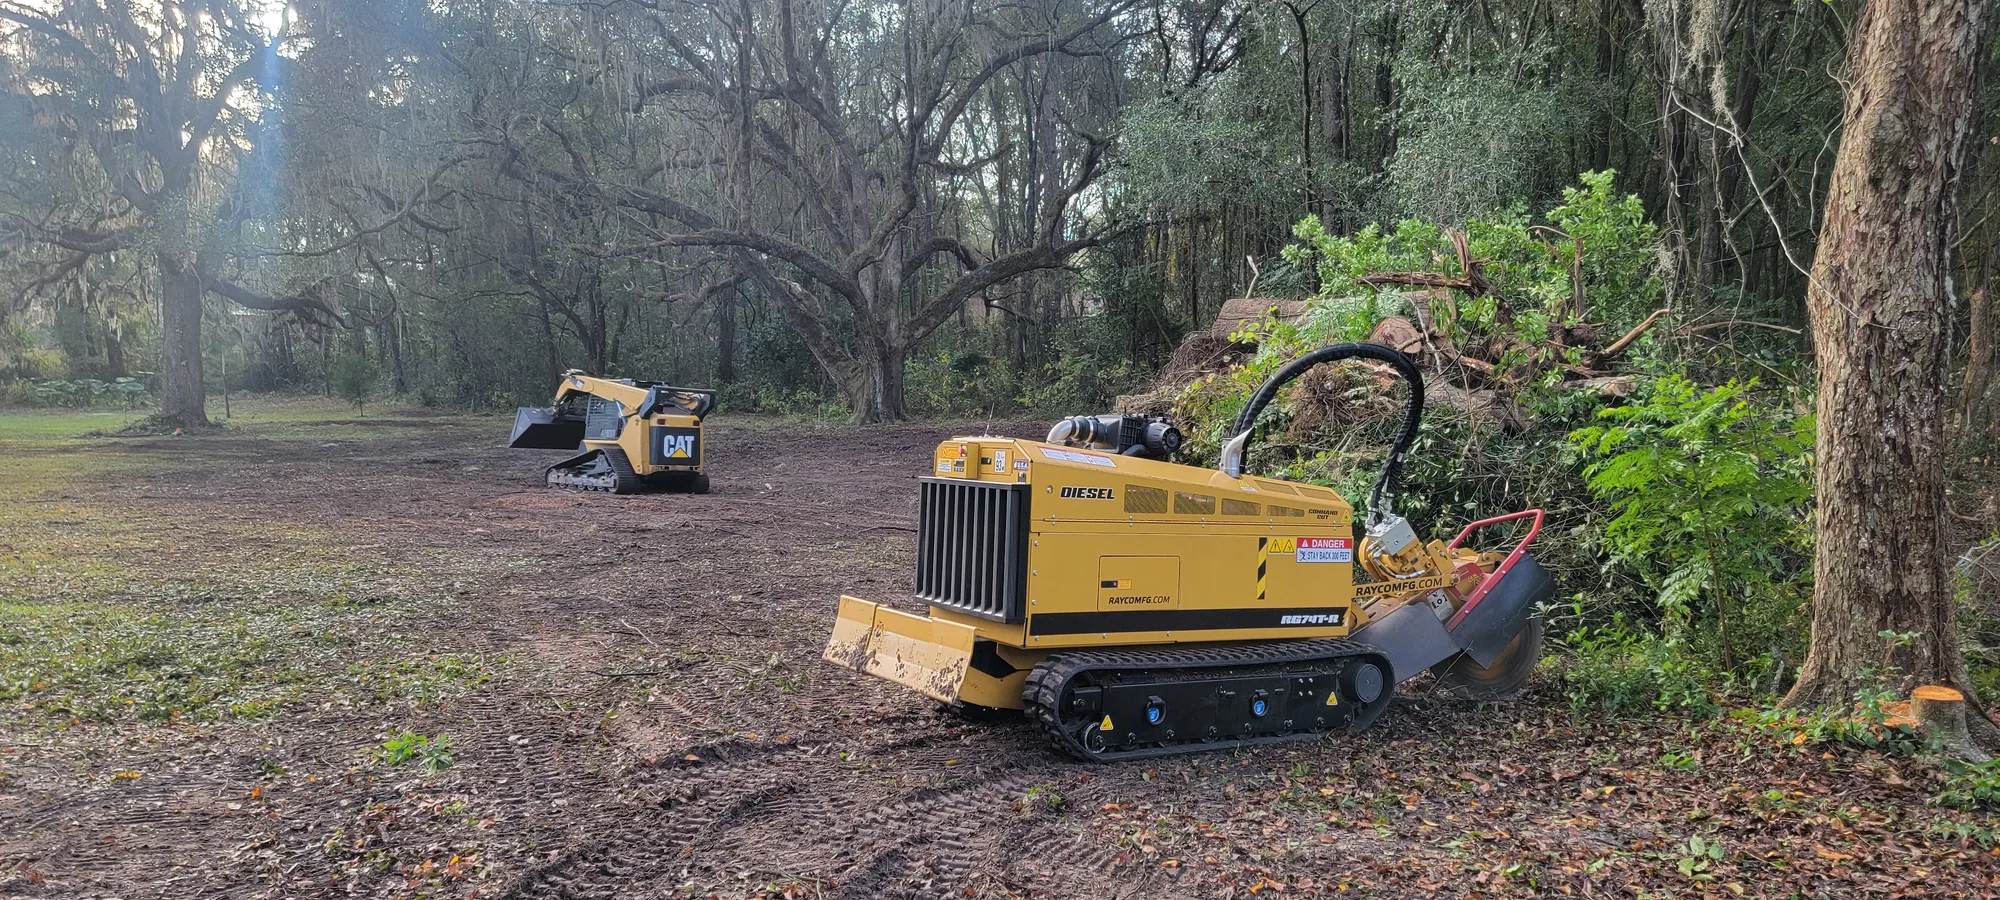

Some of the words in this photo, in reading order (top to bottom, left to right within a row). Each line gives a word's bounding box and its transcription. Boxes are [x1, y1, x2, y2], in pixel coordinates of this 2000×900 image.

[664, 435, 695, 458] CAT
[1060, 486, 1115, 500] DIESEL
[1308, 508, 1338, 516] COMMAND
[1312, 539, 1345, 548] DANGER
[1307, 551, 1318, 560] STAY
[1319, 551, 1331, 560] BACK
[1340, 551, 1350, 560] FEET
[1356, 578, 1442, 596] RAYCOMFG.COM
[1108, 596, 1171, 604] RAYCOMFG.COM
[1280, 614, 1340, 625] RG74T-R
